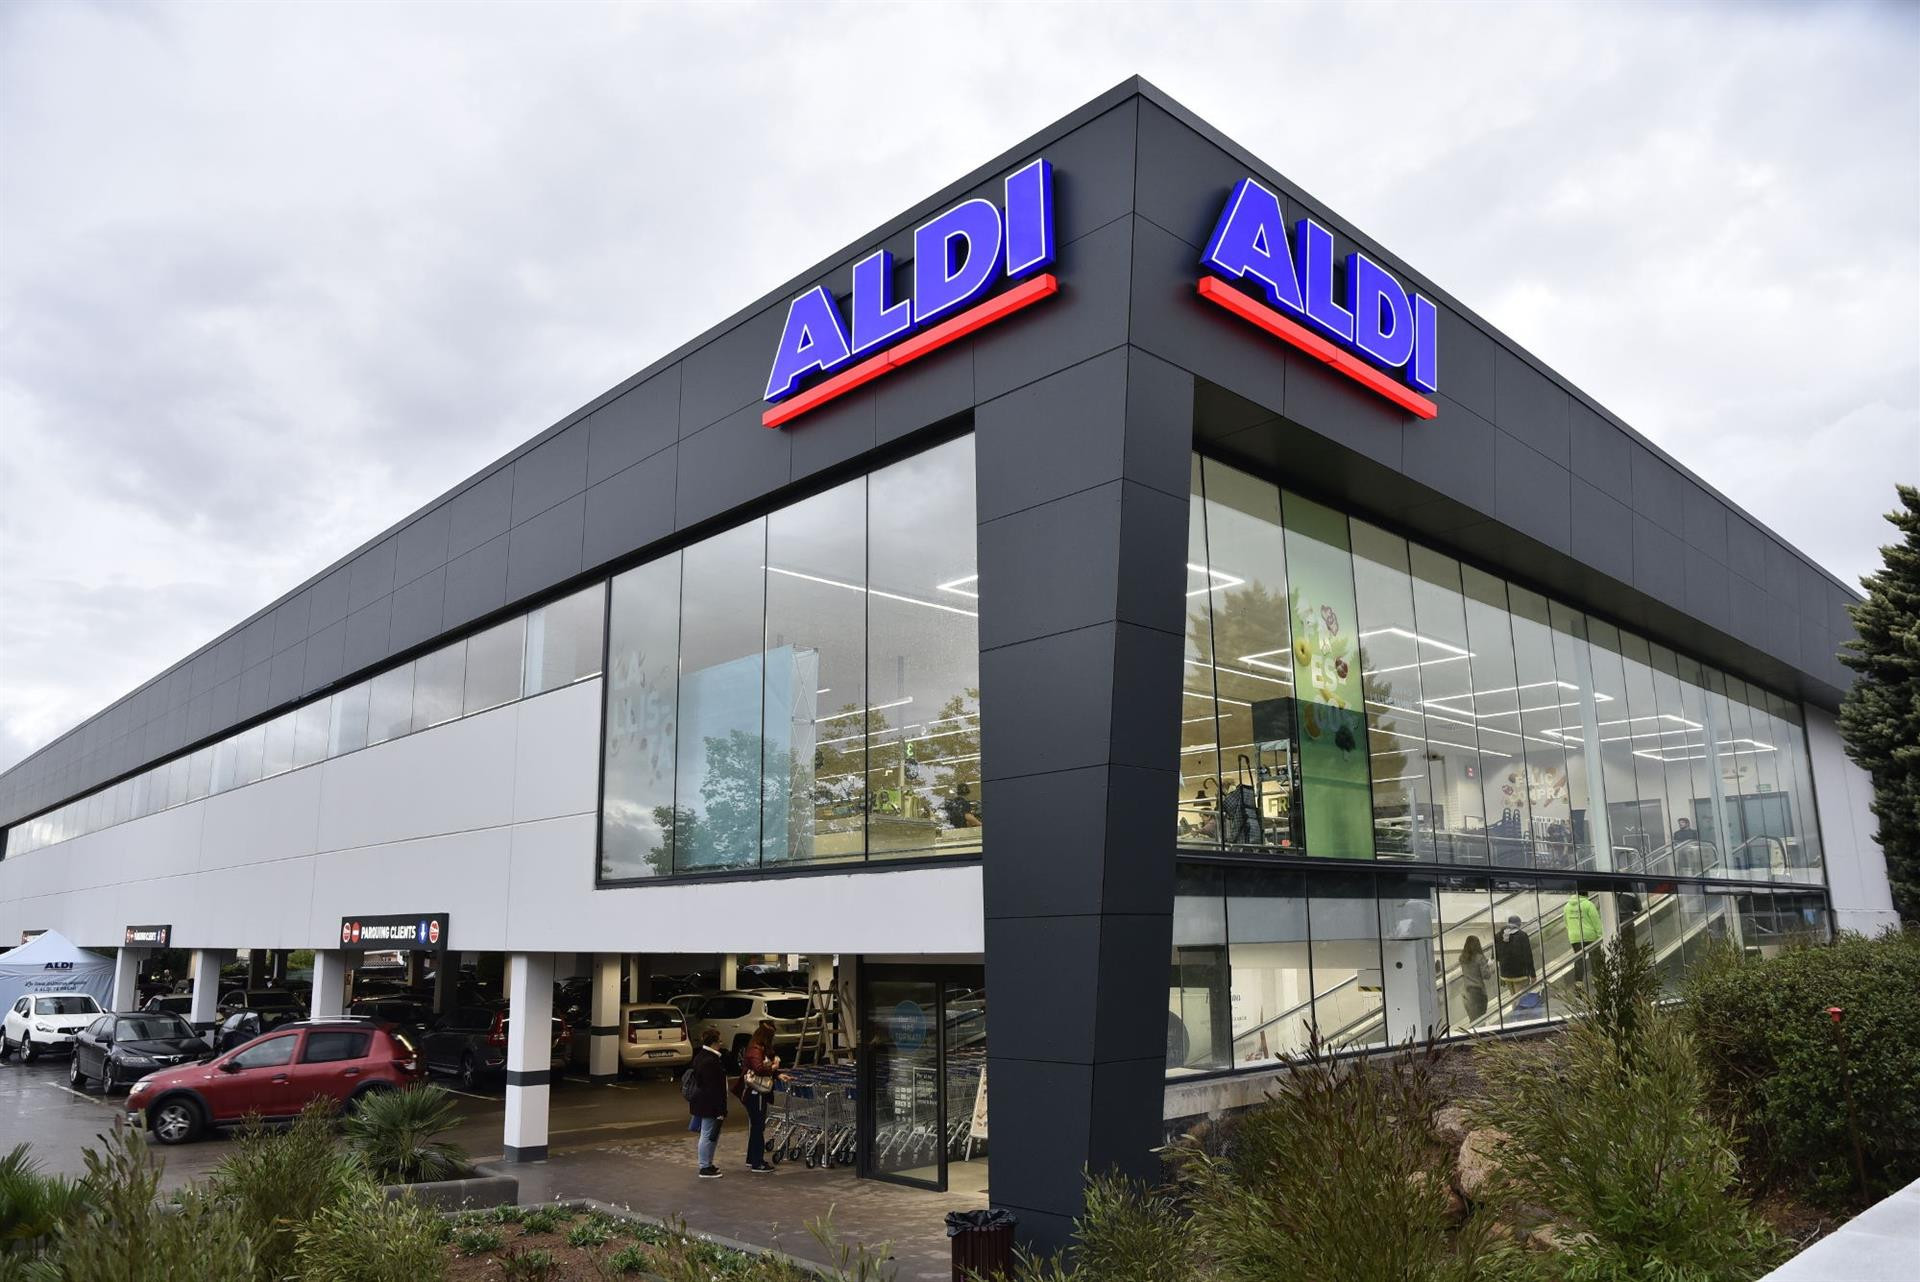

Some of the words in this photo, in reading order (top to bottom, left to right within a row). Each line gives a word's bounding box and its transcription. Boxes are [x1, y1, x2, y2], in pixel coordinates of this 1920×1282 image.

[764, 157, 1056, 403] ALDI
[1200, 177, 1437, 394] ALDI
[390, 925, 416, 939] CLIENTS
